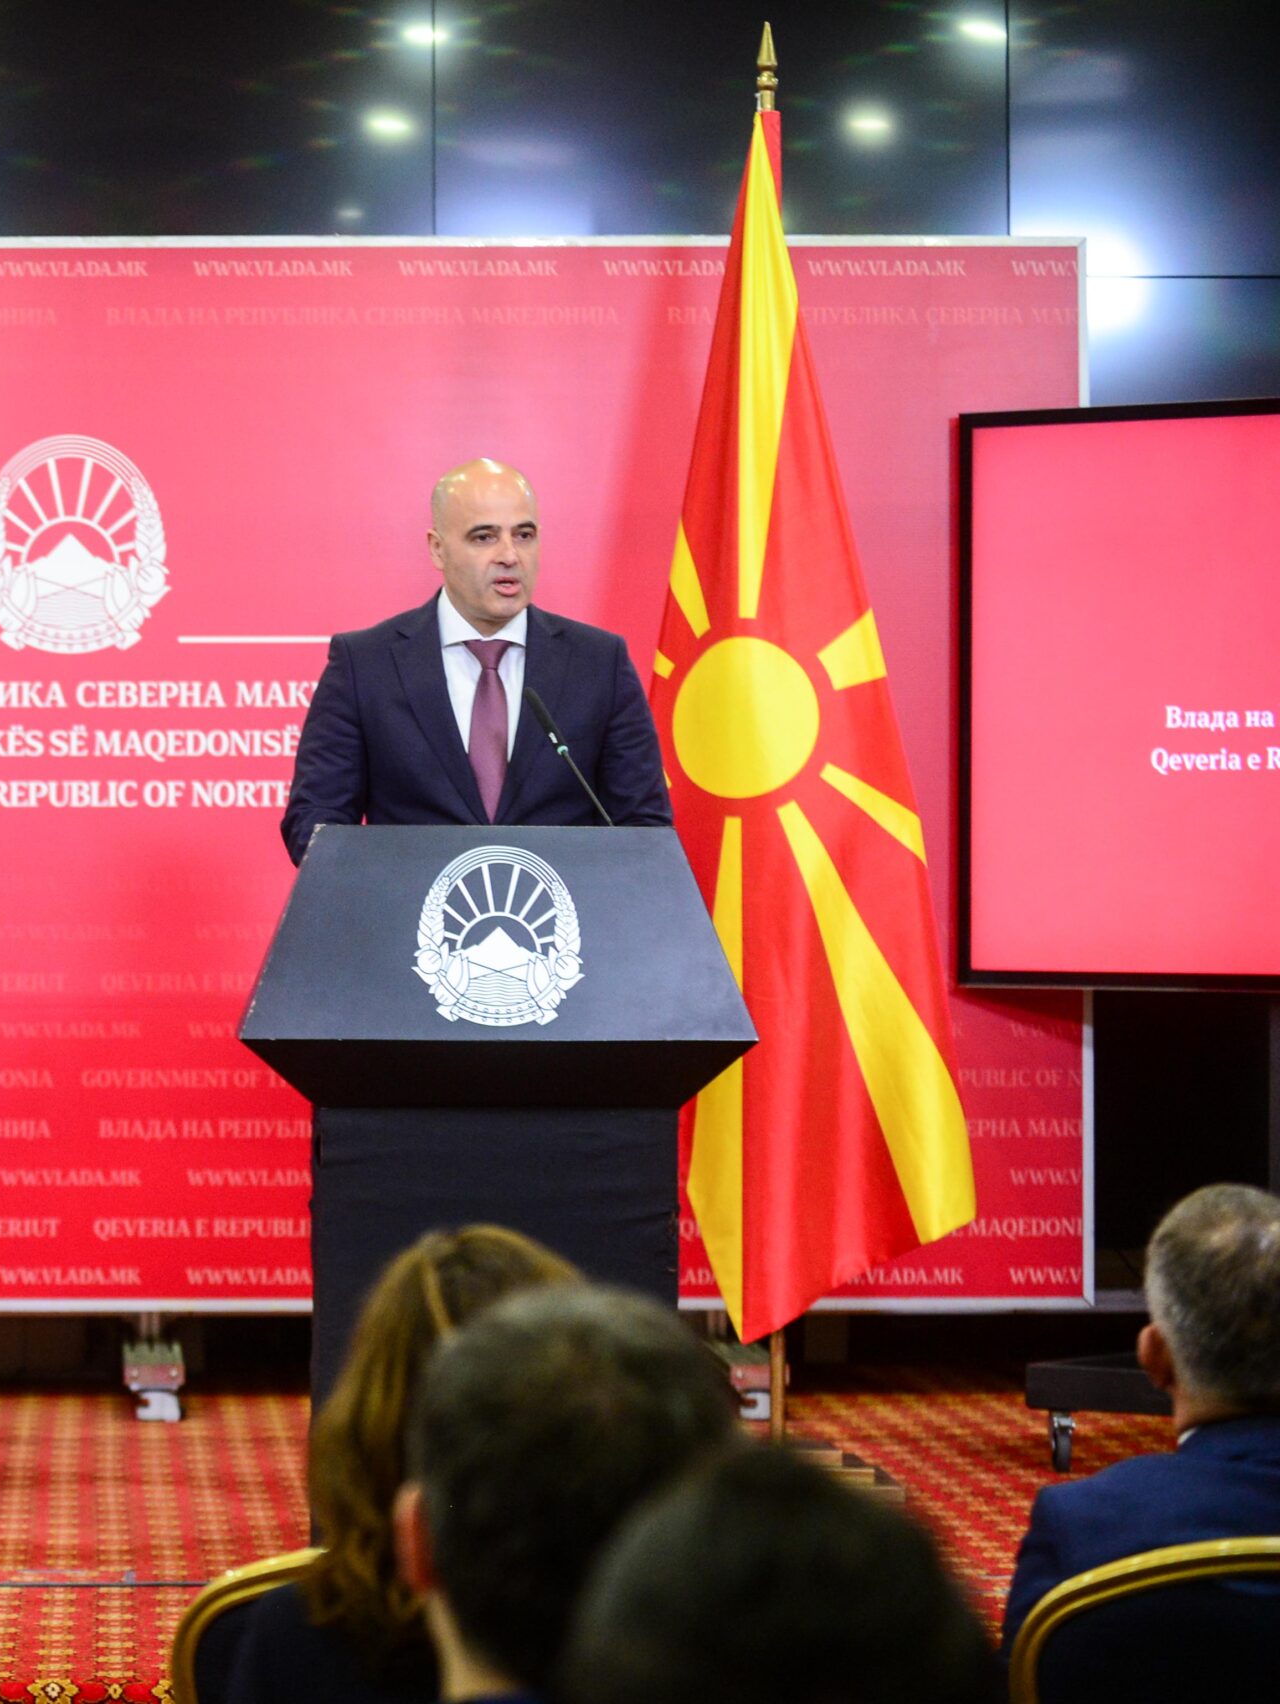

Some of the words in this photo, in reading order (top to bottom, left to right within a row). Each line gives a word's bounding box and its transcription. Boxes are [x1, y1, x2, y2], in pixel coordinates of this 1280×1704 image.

[192, 260, 354, 276] WWW.VLADA.MK
[397, 260, 559, 276] WWW.VLADA.MK
[602, 260, 726, 276] WWW.VLADA
[807, 260, 968, 276] WWW.VLADA.MK
[75, 680, 227, 709] СЕВЕРНА
[1165, 705, 1239, 732] Влада
[1245, 709, 1275, 728] на
[49, 724, 89, 757] SË
[94, 724, 302, 763] MAQEDONISË
[1150, 747, 1242, 776] Qeveria
[1246, 752, 1261, 771] e
[142, 780, 187, 808] OF
[81, 1069, 230, 1088] GOVERNMENT
[959, 1068, 1031, 1087] PUBLIC
[99, 1119, 179, 1141] ВЛАДА
[182, 1119, 215, 1138] НА
[186, 1169, 312, 1186] WWW.VLADA
[93, 1217, 190, 1241] QEVERIA
[195, 1217, 209, 1237] E
[213, 1217, 312, 1238] REPUBLI
[185, 1267, 312, 1285] WWW.VLADA
